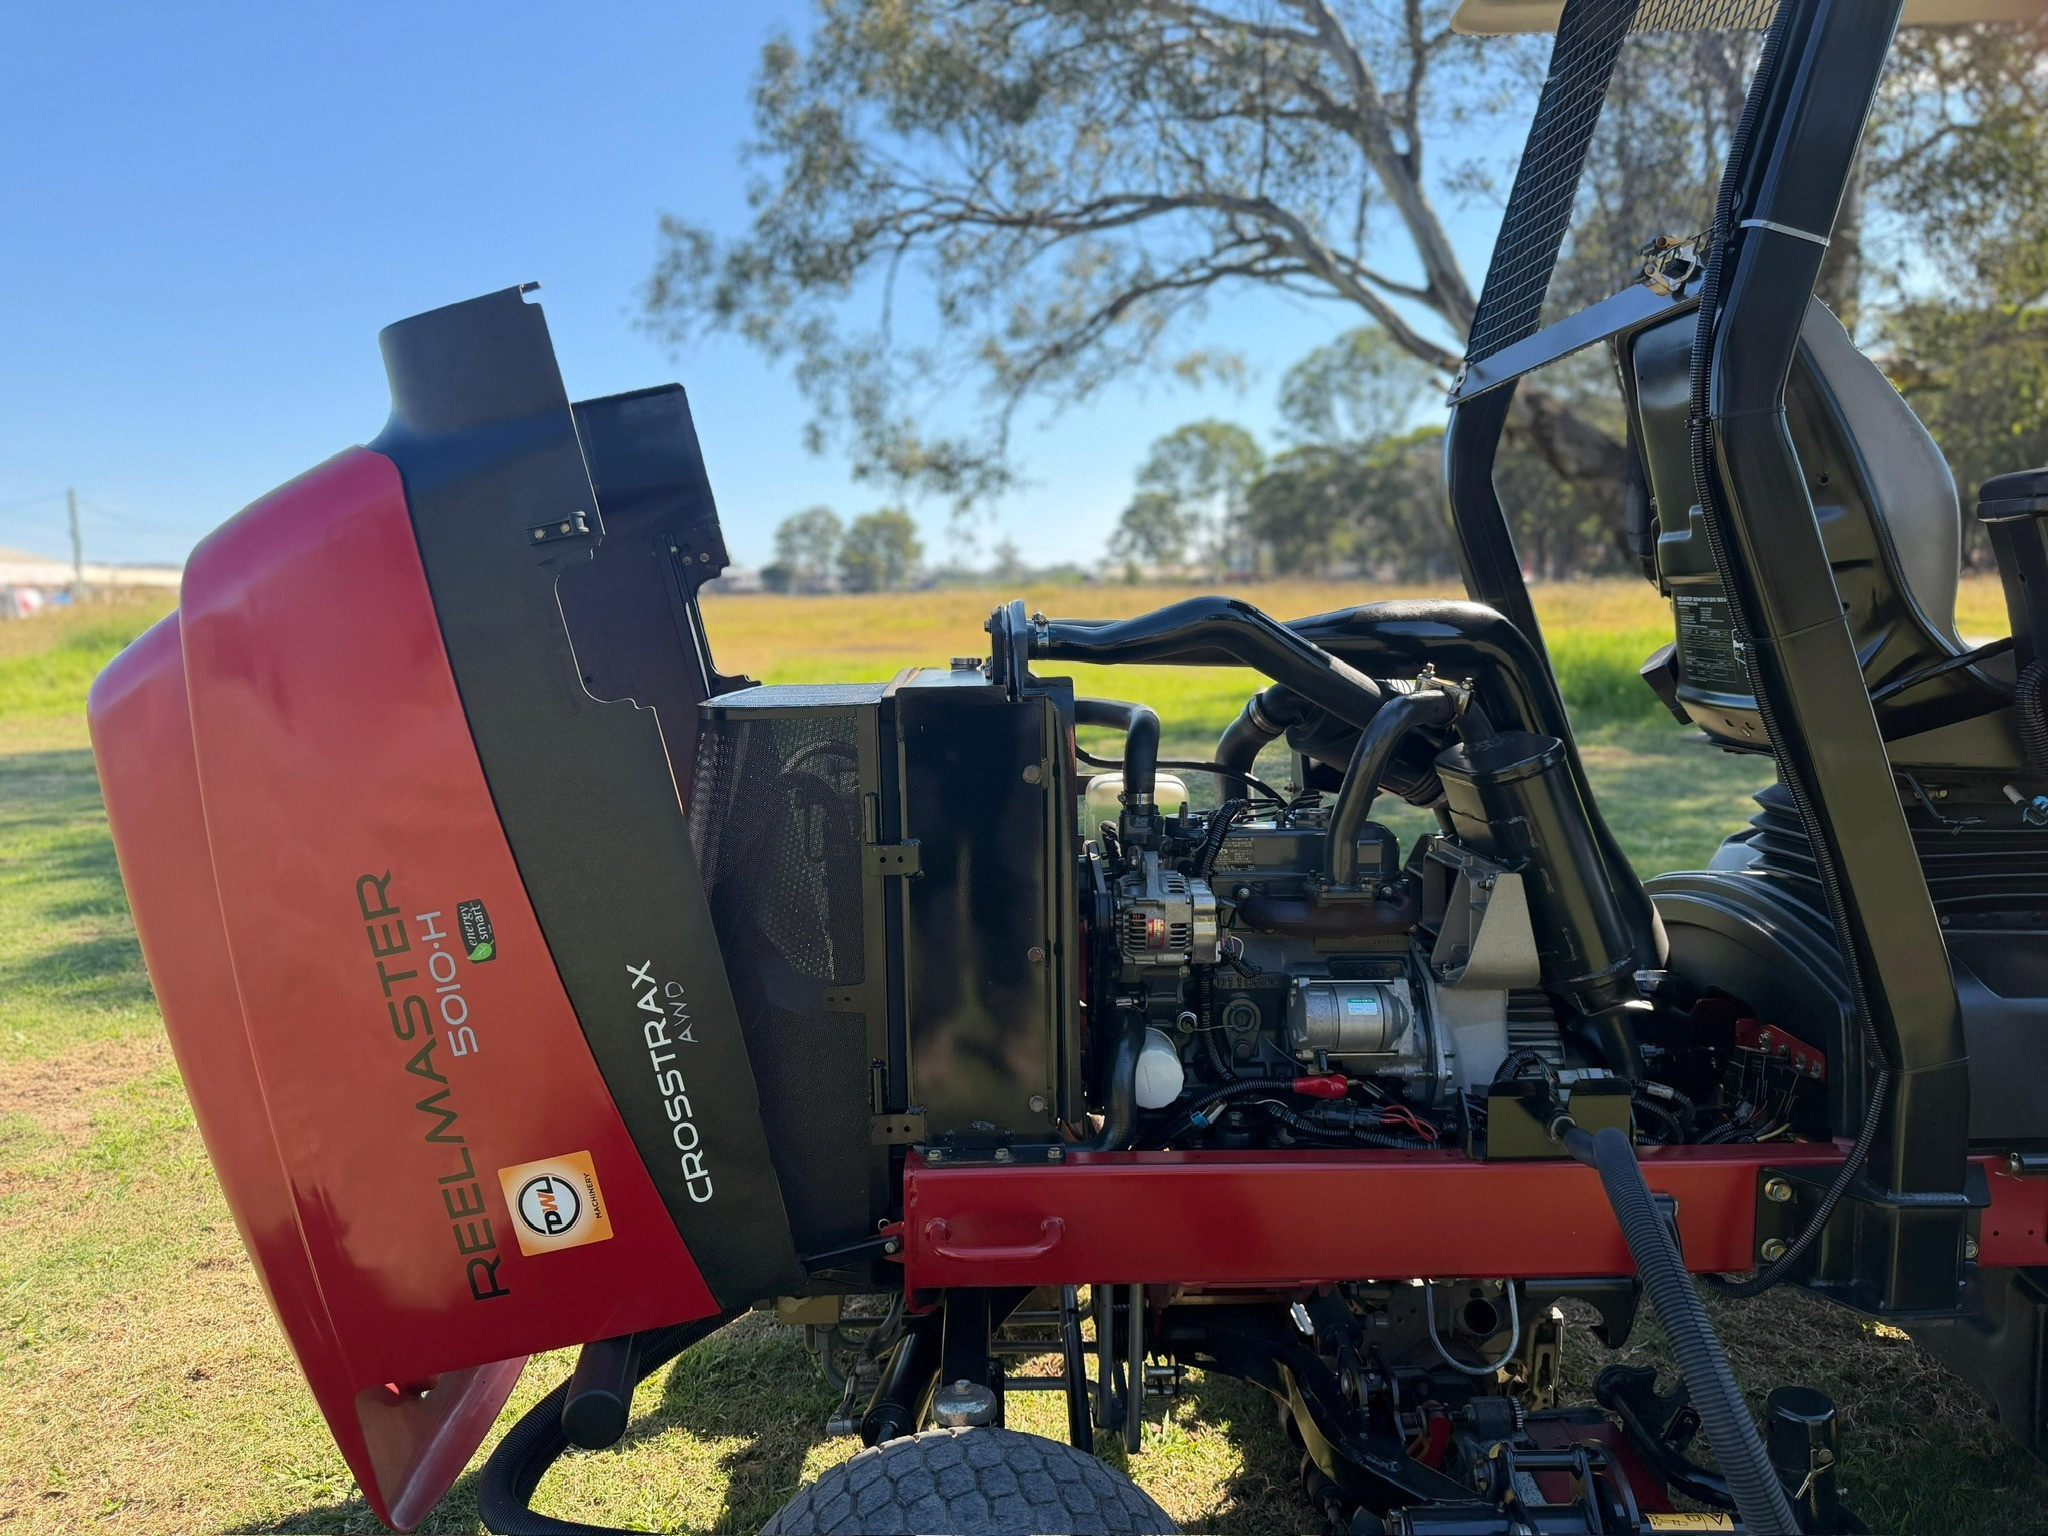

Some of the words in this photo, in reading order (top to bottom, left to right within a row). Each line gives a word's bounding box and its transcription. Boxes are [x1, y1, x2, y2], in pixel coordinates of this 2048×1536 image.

[460, 902, 478, 946] energy
[471, 903, 489, 940] smart
[665, 981, 699, 1043] AWD
[355, 869, 511, 1300] REELMASTER
[626, 959, 713, 1203] CROSSTRAX
[583, 1172, 603, 1219] MACHINERY
